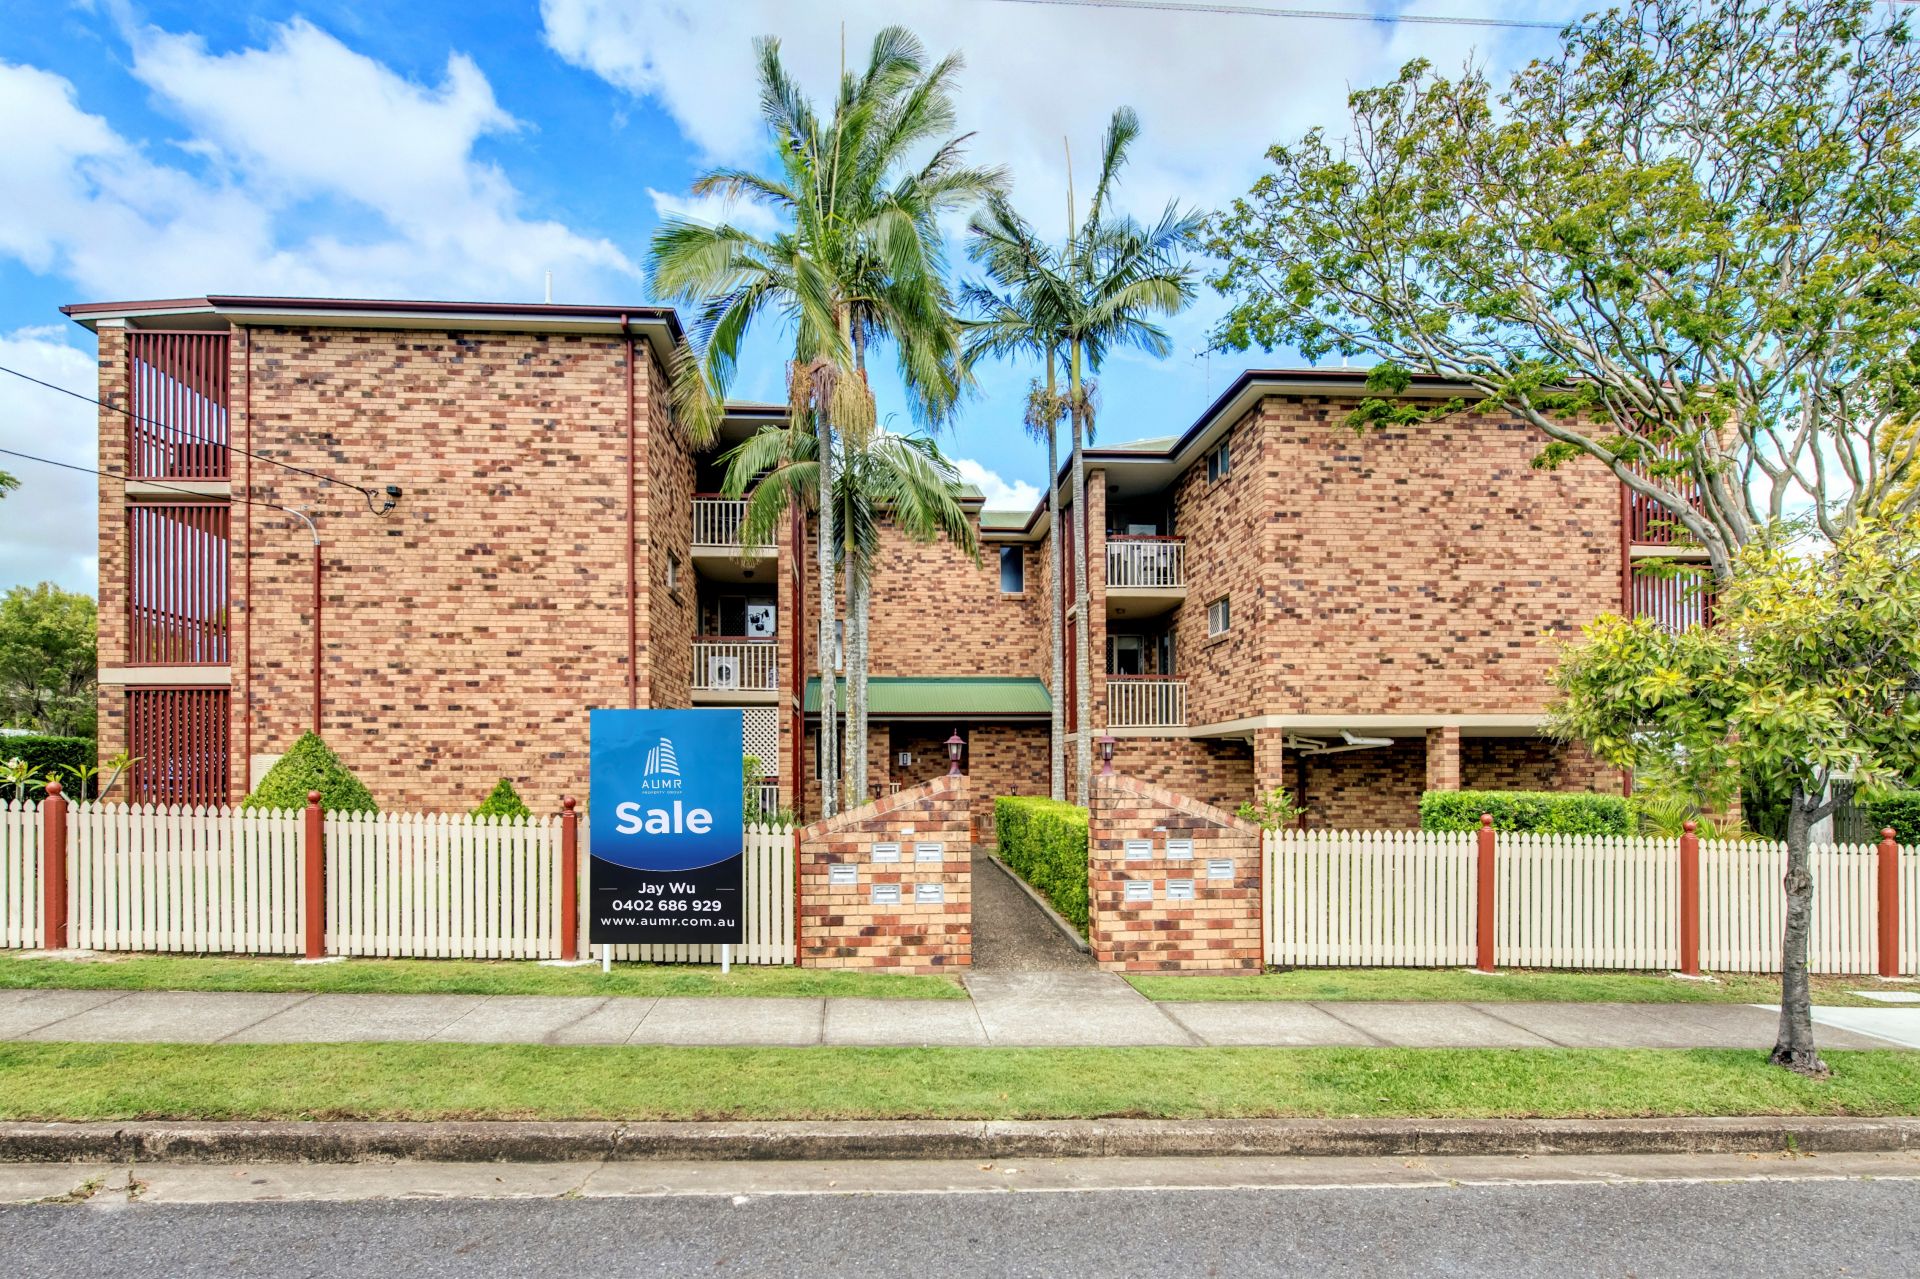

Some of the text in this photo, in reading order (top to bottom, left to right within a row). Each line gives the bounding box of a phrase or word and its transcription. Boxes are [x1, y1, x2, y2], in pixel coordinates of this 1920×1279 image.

[641, 779, 682, 789] AUMR
[615, 800, 713, 834] Sale
[638, 882, 696, 896] Jay Wu
[612, 900, 722, 911] 0402 686 929
[600, 917, 735, 927] www.aumr.com.au
